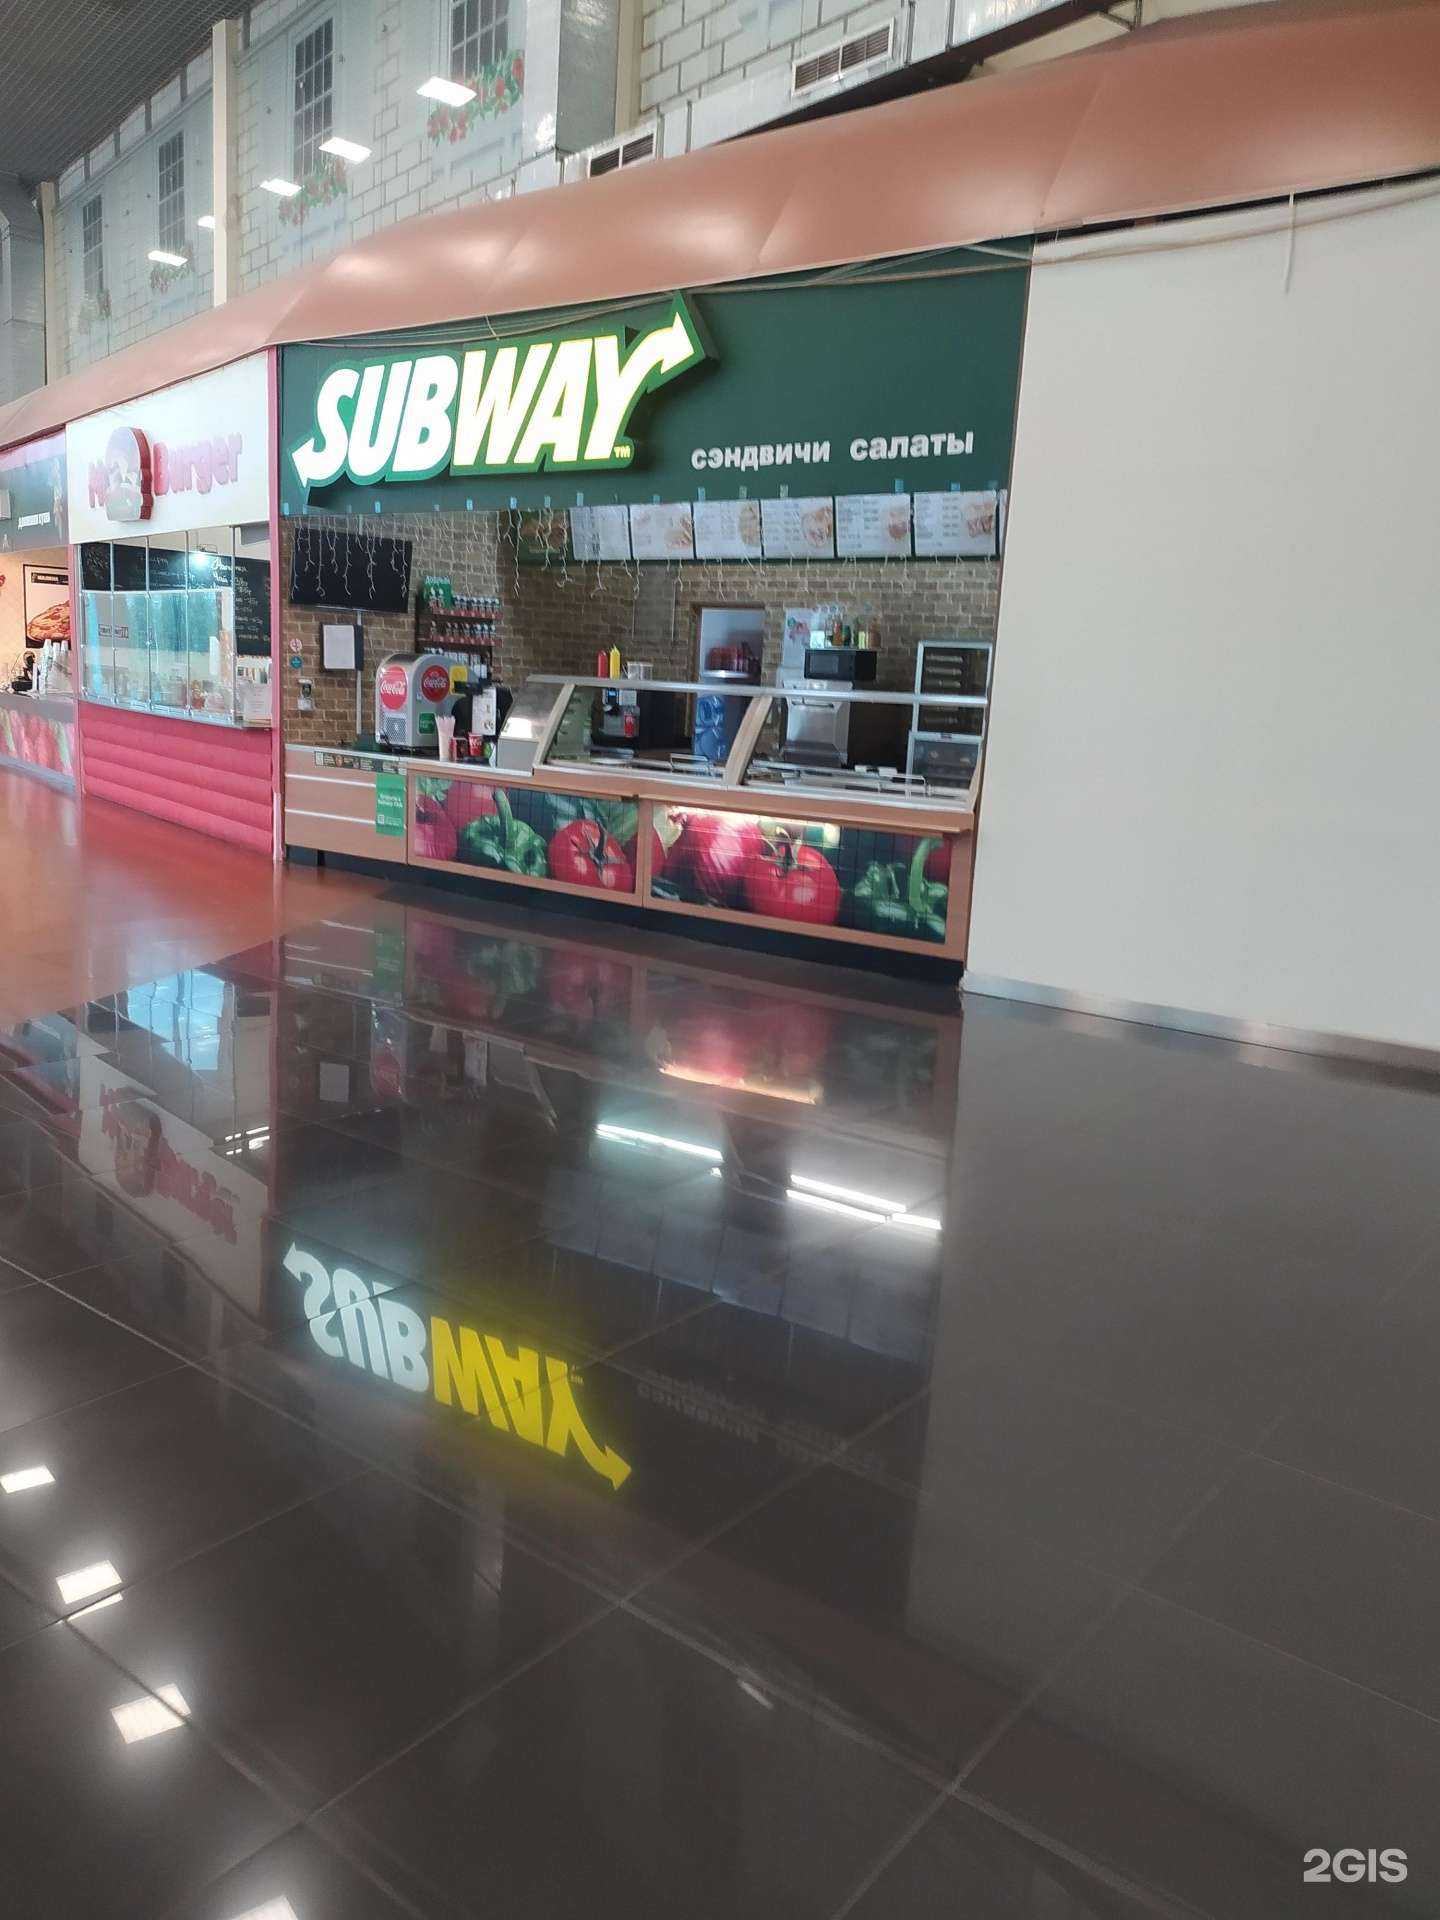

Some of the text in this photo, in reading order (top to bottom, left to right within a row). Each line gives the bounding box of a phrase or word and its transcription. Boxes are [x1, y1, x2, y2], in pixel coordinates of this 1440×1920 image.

[292, 312, 695, 488] SUBWAY
[691, 431, 974, 472] сэндвичи салаты
